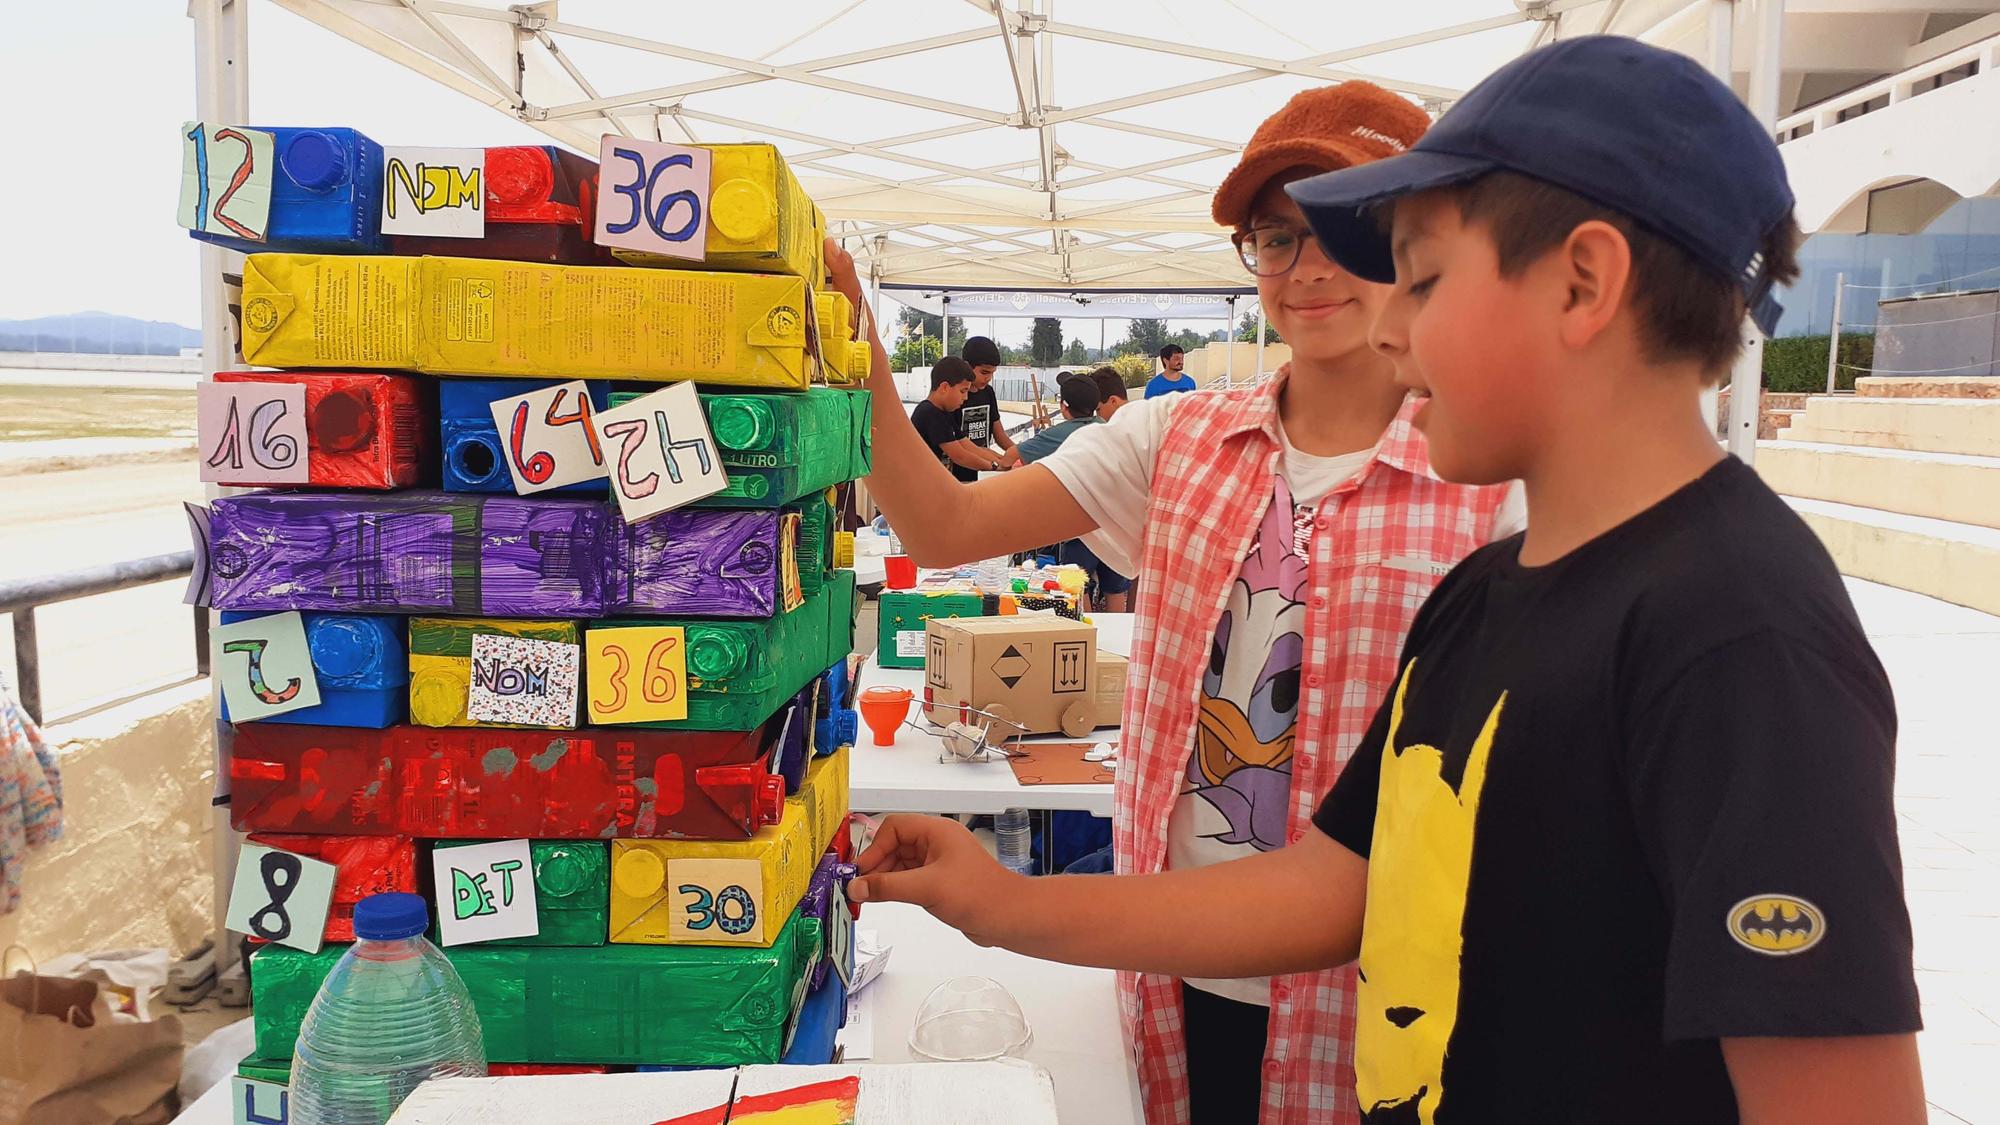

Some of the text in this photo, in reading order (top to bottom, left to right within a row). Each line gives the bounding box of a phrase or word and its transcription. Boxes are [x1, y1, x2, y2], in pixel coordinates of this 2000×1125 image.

[187, 122, 262, 239] 12
[386, 158, 480, 219] NOM
[606, 147, 701, 242] 36
[207, 396, 298, 470] 16
[510, 388, 604, 485] 64
[968, 421, 986, 430] BREAK
[474, 657, 550, 696] NOM
[593, 637, 678, 714] 36
[616, 741, 635, 828] ENTERA
[249, 851, 302, 941] 8
[451, 859, 522, 921] DET
[678, 884, 756, 935] 30
